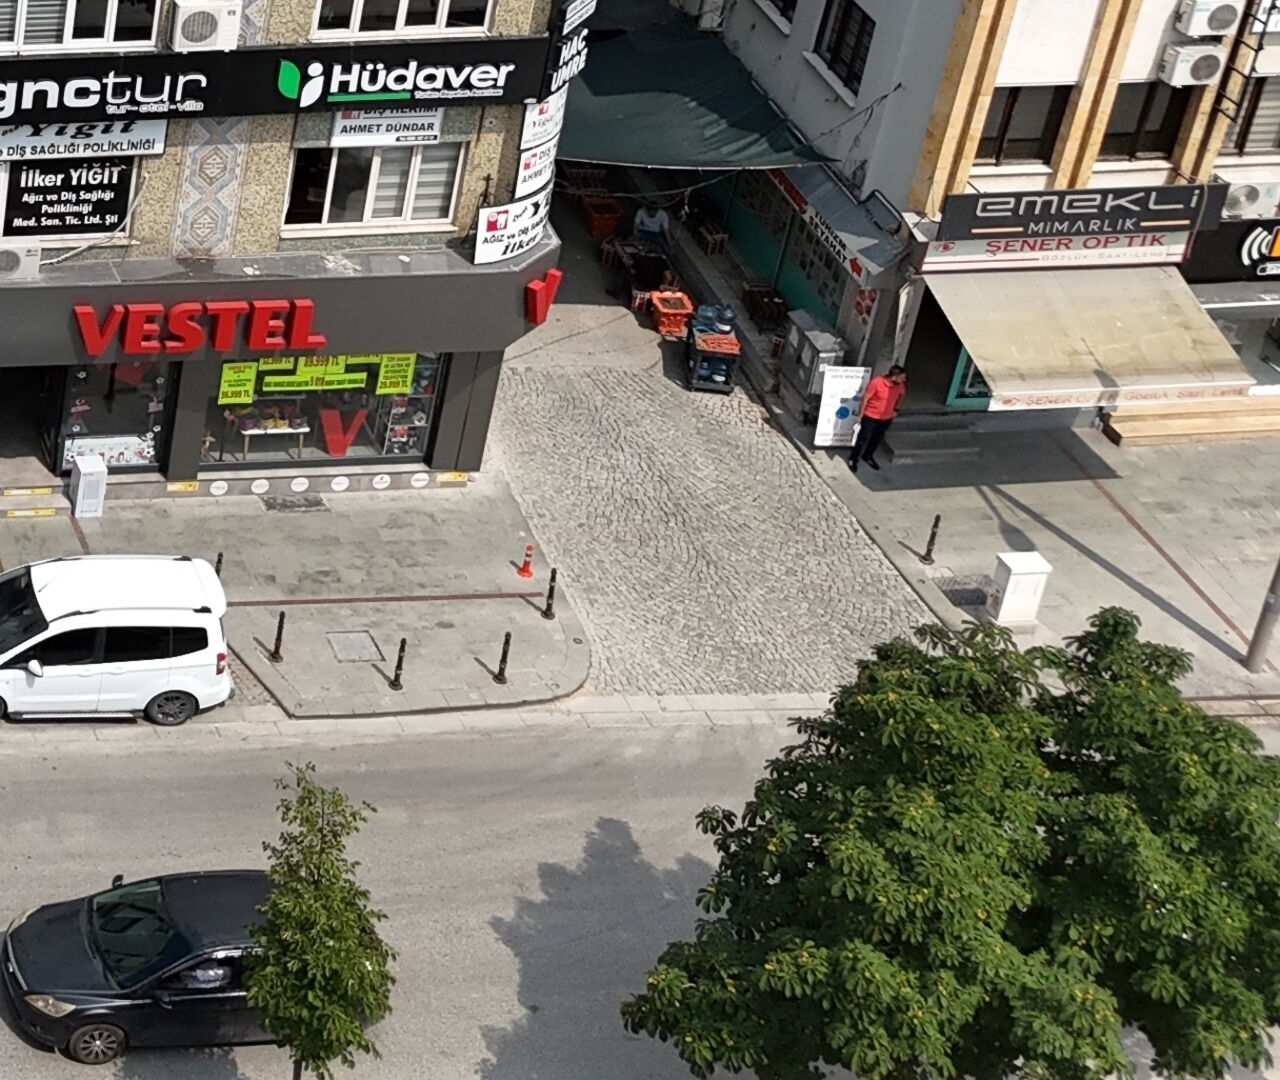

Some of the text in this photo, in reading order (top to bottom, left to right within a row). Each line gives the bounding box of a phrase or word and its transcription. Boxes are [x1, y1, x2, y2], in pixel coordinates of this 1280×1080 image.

[559, 28, 589, 66] HAC
[329, 60, 516, 93] Hüdaver
[551, 47, 588, 92] UMRE
[341, 122, 435, 134] AHMET DÜNDAR
[7, 144, 26, 158] DİŞ
[30, 141, 79, 156] SAĞLIĞI
[83, 138, 155, 153] POLİKLİNİĞİ
[20, 162, 123, 187] İlker YİĞİT
[22, 190, 115, 204] Ağız ve Diş Sağlığı
[42, 203, 92, 214] Polikliniği
[13, 217, 38, 227] Med.
[41, 216, 62, 226] San.
[65, 215, 81, 225] Tic.
[84, 214, 102, 225] Ltd.
[482, 233, 505, 244] AĞIZ
[985, 238, 1073, 257] ŞENER
[72, 299, 327, 356] VESTEL
